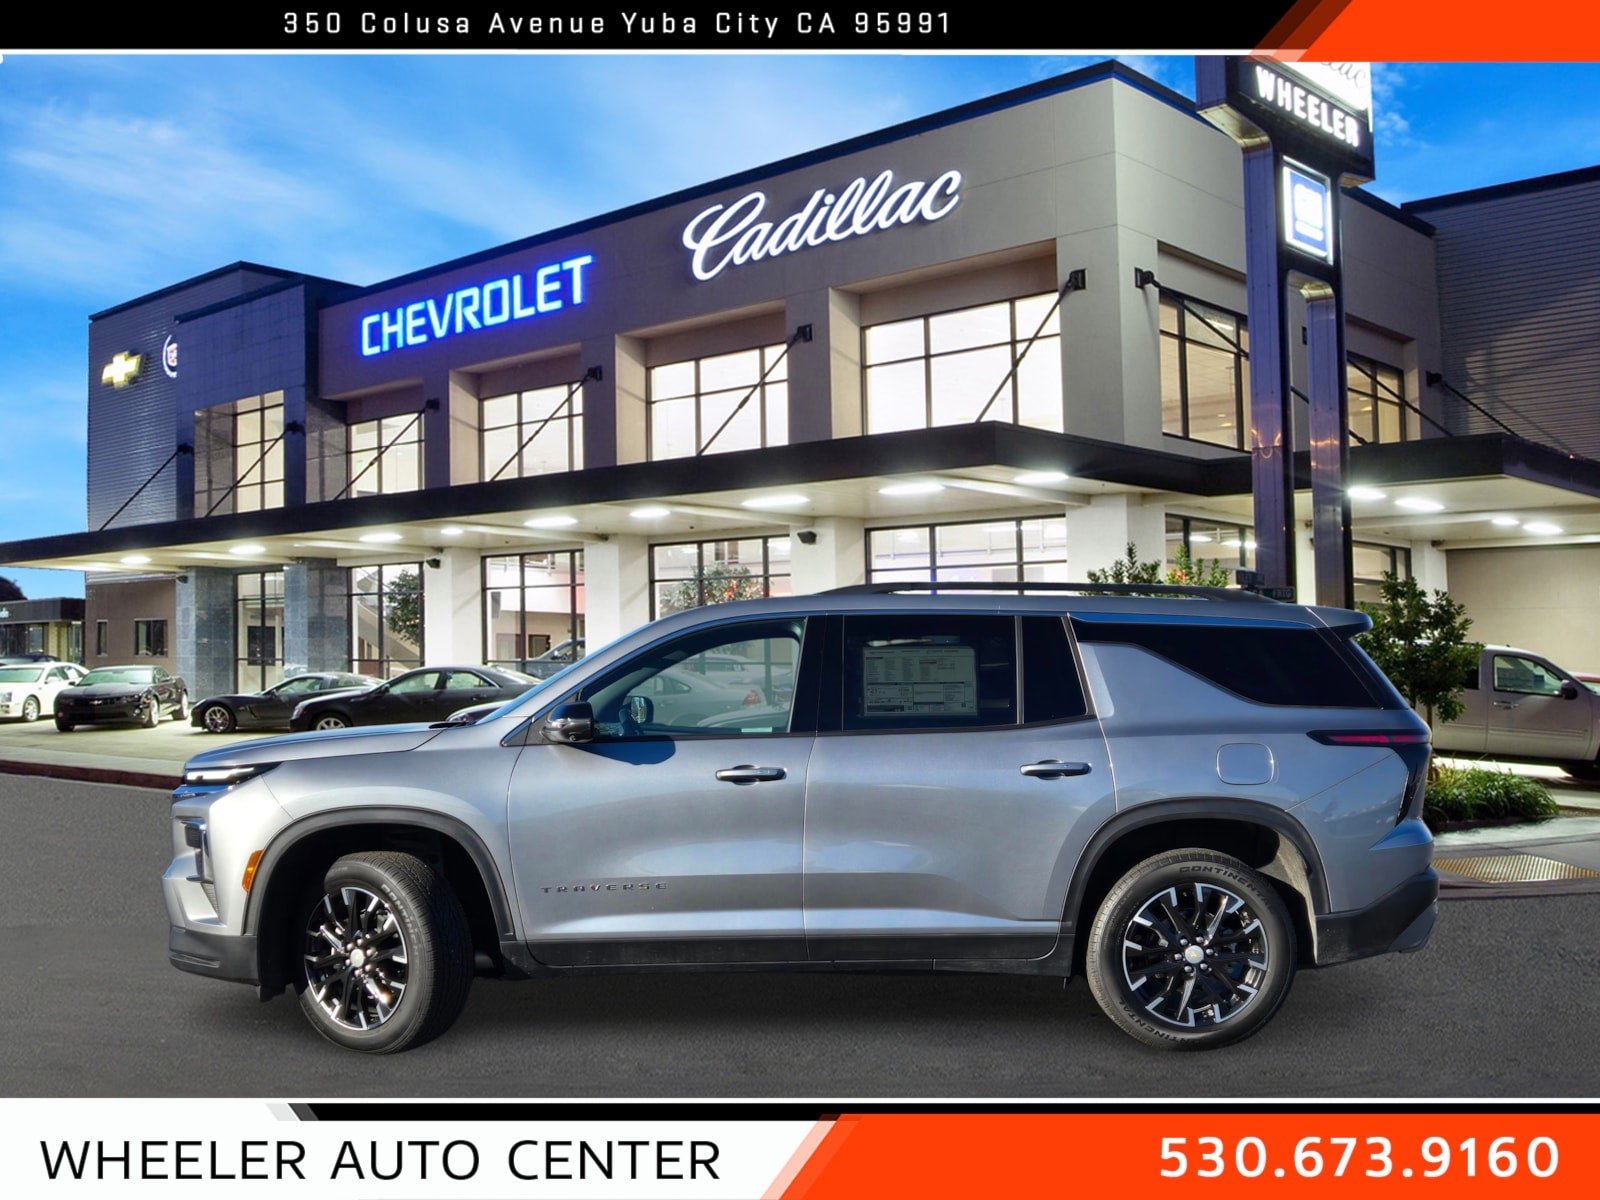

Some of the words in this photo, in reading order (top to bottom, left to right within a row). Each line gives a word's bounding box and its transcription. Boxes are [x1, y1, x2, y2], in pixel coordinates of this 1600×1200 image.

[1254, 66, 1360, 148] WHEELER
[682, 169, 963, 282] Cadillac
[360, 255, 593, 358] CHEVROLET
[541, 882, 667, 894] TRAVERSE
